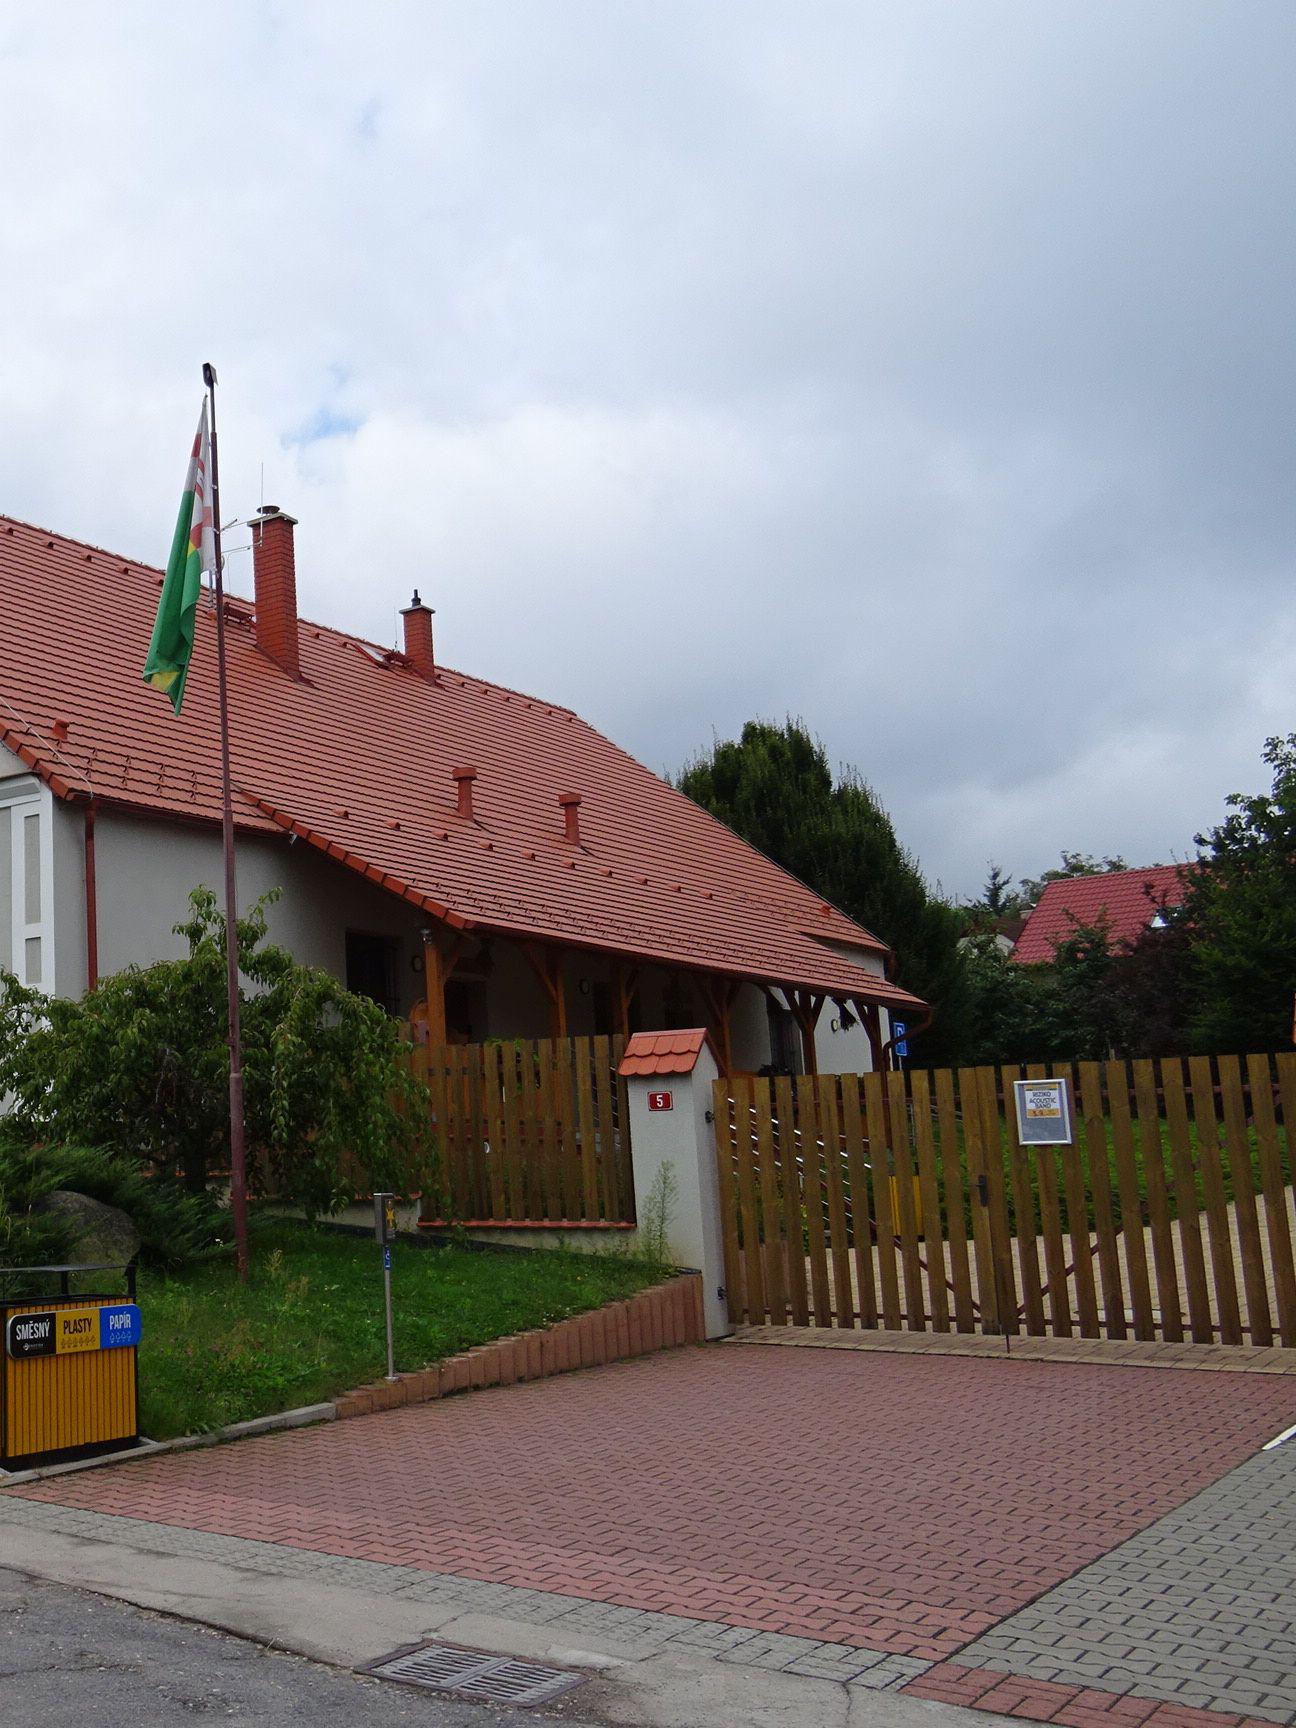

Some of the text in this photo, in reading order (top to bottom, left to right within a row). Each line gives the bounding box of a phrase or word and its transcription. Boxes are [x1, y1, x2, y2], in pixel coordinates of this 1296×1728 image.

[656, 1094, 664, 1108] 5
[15, 1319, 50, 1341] SMĚSNÝ
[63, 1316, 92, 1335] PLASTY
[109, 1312, 131, 1330] PAPÍR
